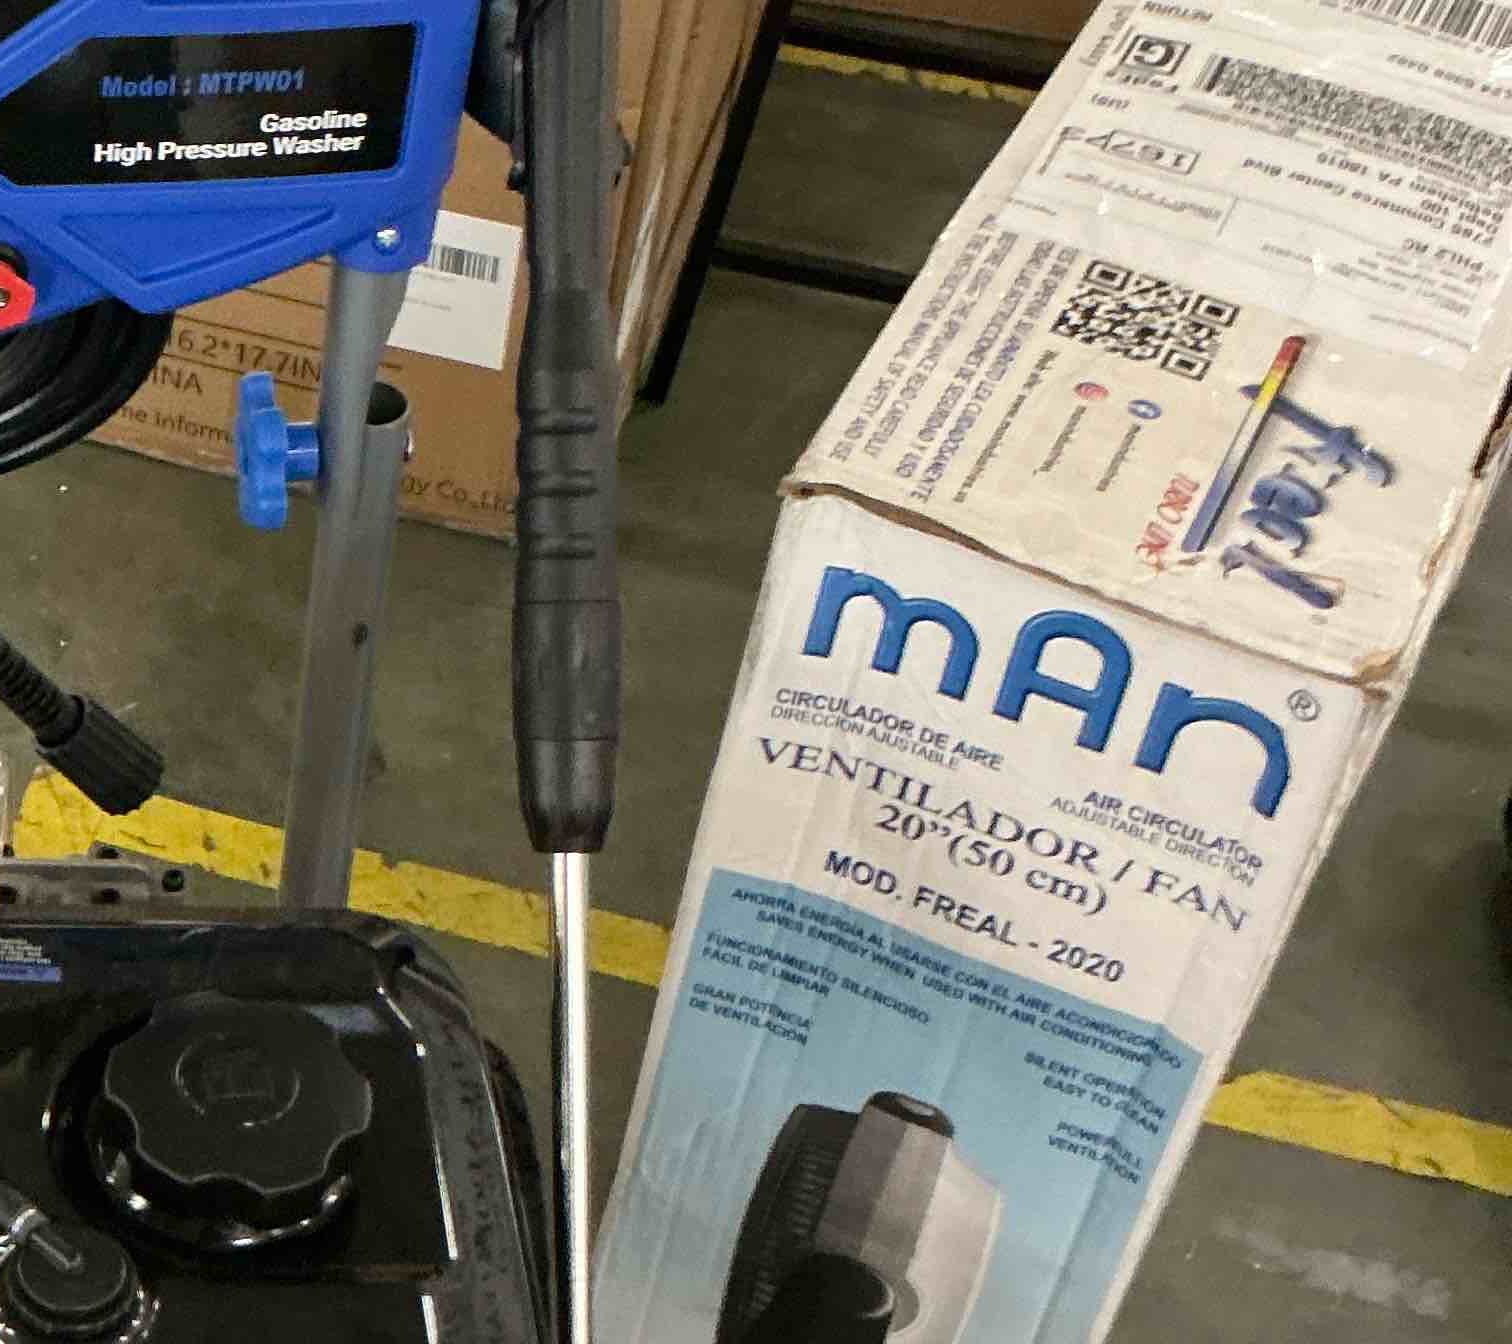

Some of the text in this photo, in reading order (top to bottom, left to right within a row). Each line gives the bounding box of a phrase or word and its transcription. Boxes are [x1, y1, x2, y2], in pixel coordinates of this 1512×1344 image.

[101, 74, 177, 99] Model
[198, 68, 305, 96] MTPW01
[94, 132, 365, 168] High Pressure Washer
[260, 109, 367, 135] Gasoline
[1288, 170, 1344, 197] Center
[774, 686, 1005, 771] CIRCULADOR DE AIRE
[752, 733, 1105, 876] VENTILADOR
[1138, 865, 1253, 936] FAN
[1047, 793, 1256, 888] ADJUSTABLE DIRECTION
[1082, 789, 1264, 870] AIR CIRCULATOR
[822, 848, 909, 903] MOD.
[911, 884, 1023, 948] FREAL
[1045, 936, 1127, 988] 2020
[706, 930, 931, 1024] FUNCIONAMIENTO SILENCIOSO
[746, 959, 767, 975] DE
[805, 925, 869, 960] ENERGY
[869, 952, 915, 979] WHEN
[919, 973, 964, 1000] USED
[966, 990, 1007, 1015] WITH
[688, 995, 709, 1011] DE
[1042, 1075, 1087, 1100] EASY
